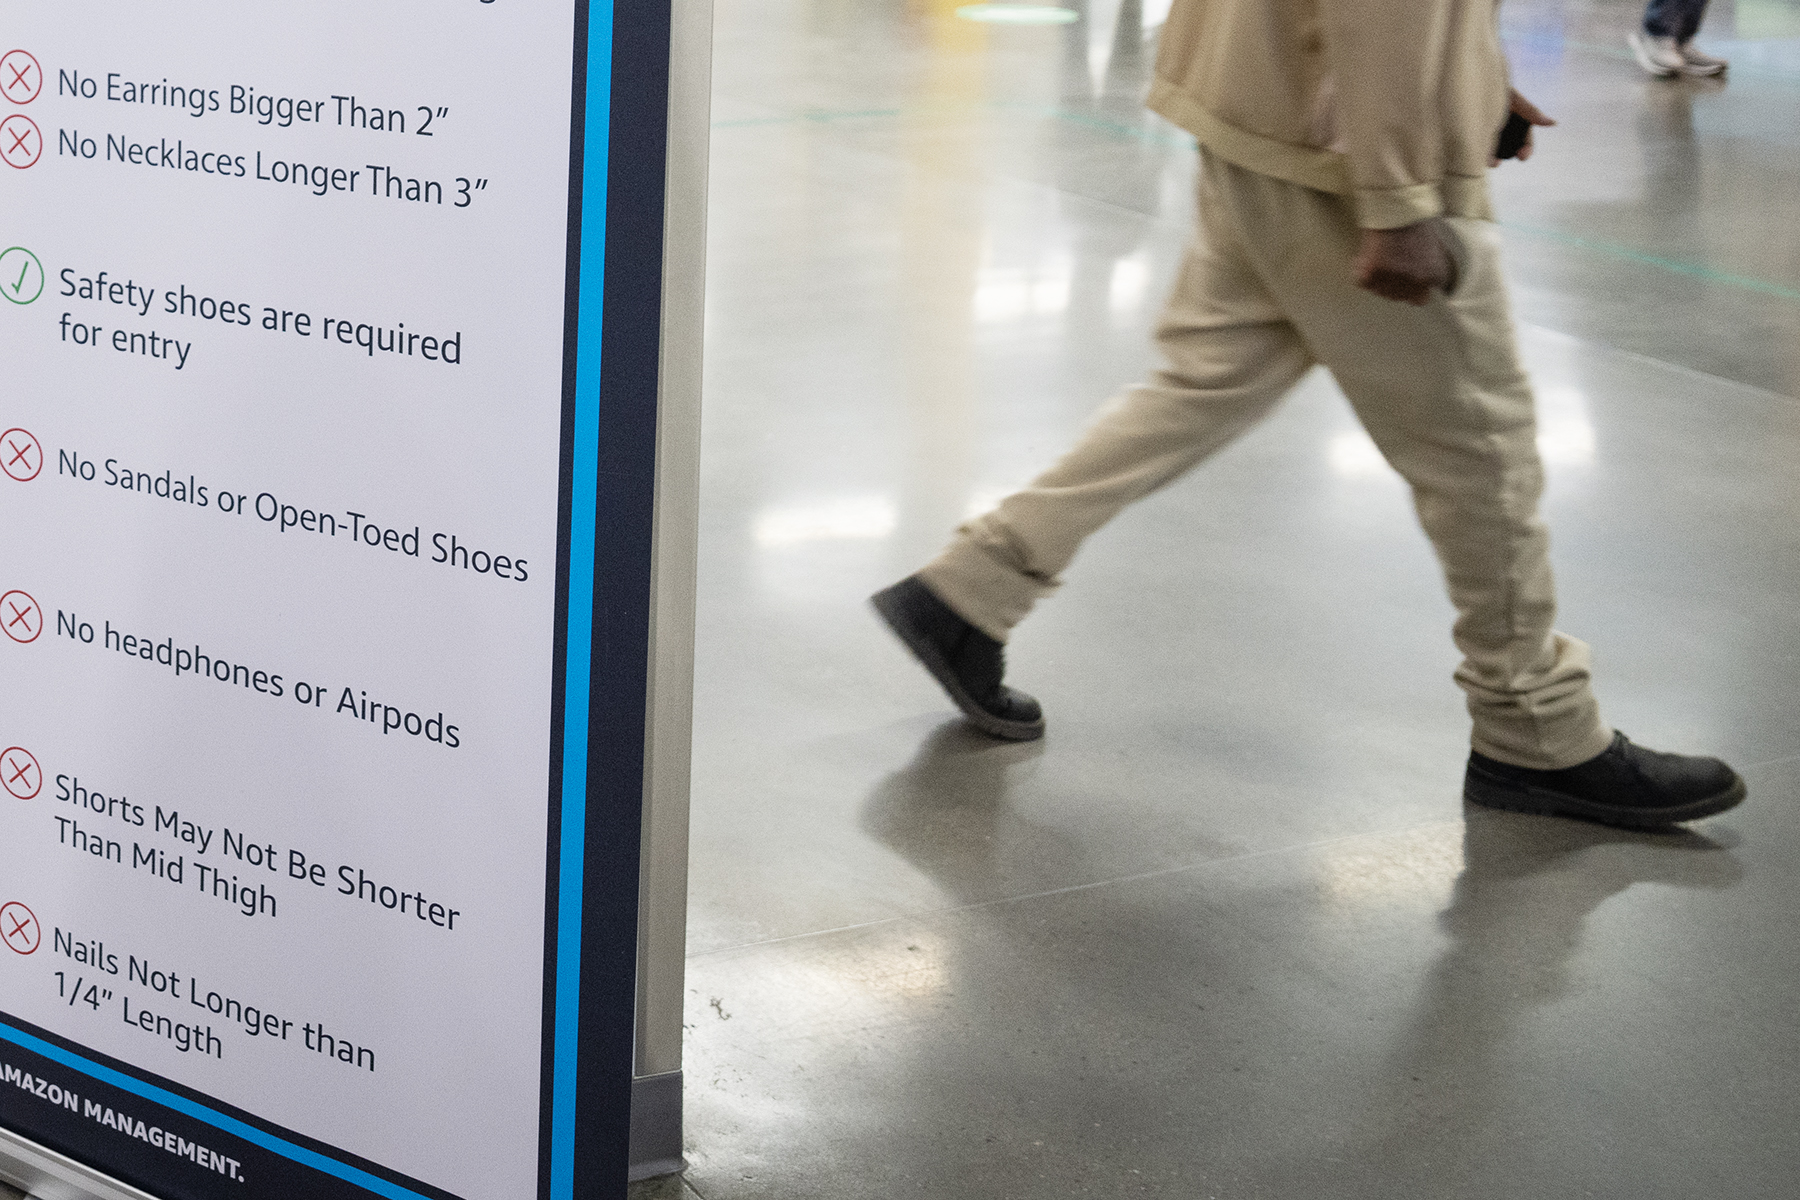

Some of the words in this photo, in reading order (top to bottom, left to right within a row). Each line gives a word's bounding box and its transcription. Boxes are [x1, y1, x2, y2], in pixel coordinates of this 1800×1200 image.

[58, 68, 98, 99] No
[106, 72, 220, 119] Earrings
[229, 84, 326, 128] Bigger
[330, 94, 406, 134] Than
[58, 128, 98, 160] No
[106, 133, 247, 178] Necklaces
[256, 150, 361, 197] Longer
[365, 164, 443, 205] Than
[58, 311, 103, 347] for
[111, 329, 192, 371] entry
[59, 267, 155, 317] Safety
[164, 284, 252, 327] shoes
[261, 306, 312, 337] are
[323, 317, 462, 365] required
[58, 448, 96, 482] No
[104, 458, 209, 508] Sandals
[217, 490, 248, 516] or
[254, 492, 420, 558] Open-Toed
[431, 532, 529, 583] Shoes
[57, 609, 95, 644] No
[104, 620, 284, 698] headphones
[294, 681, 328, 708] or
[335, 686, 461, 749] Airpods
[53, 815, 122, 864] Than
[132, 842, 184, 885] Mid
[192, 862, 277, 918] Thigh
[55, 773, 145, 827] Shorts
[154, 805, 214, 855] May
[223, 827, 278, 872] Not
[288, 848, 327, 887] Be
[337, 864, 461, 931] Shorter
[53, 926, 119, 976] Nails
[128, 954, 181, 999] Not
[190, 977, 294, 1041] Longer
[301, 1022, 375, 1073] than
[123, 991, 224, 1060] Length
[84, 1103, 245, 1182] MANAGEMENT.
